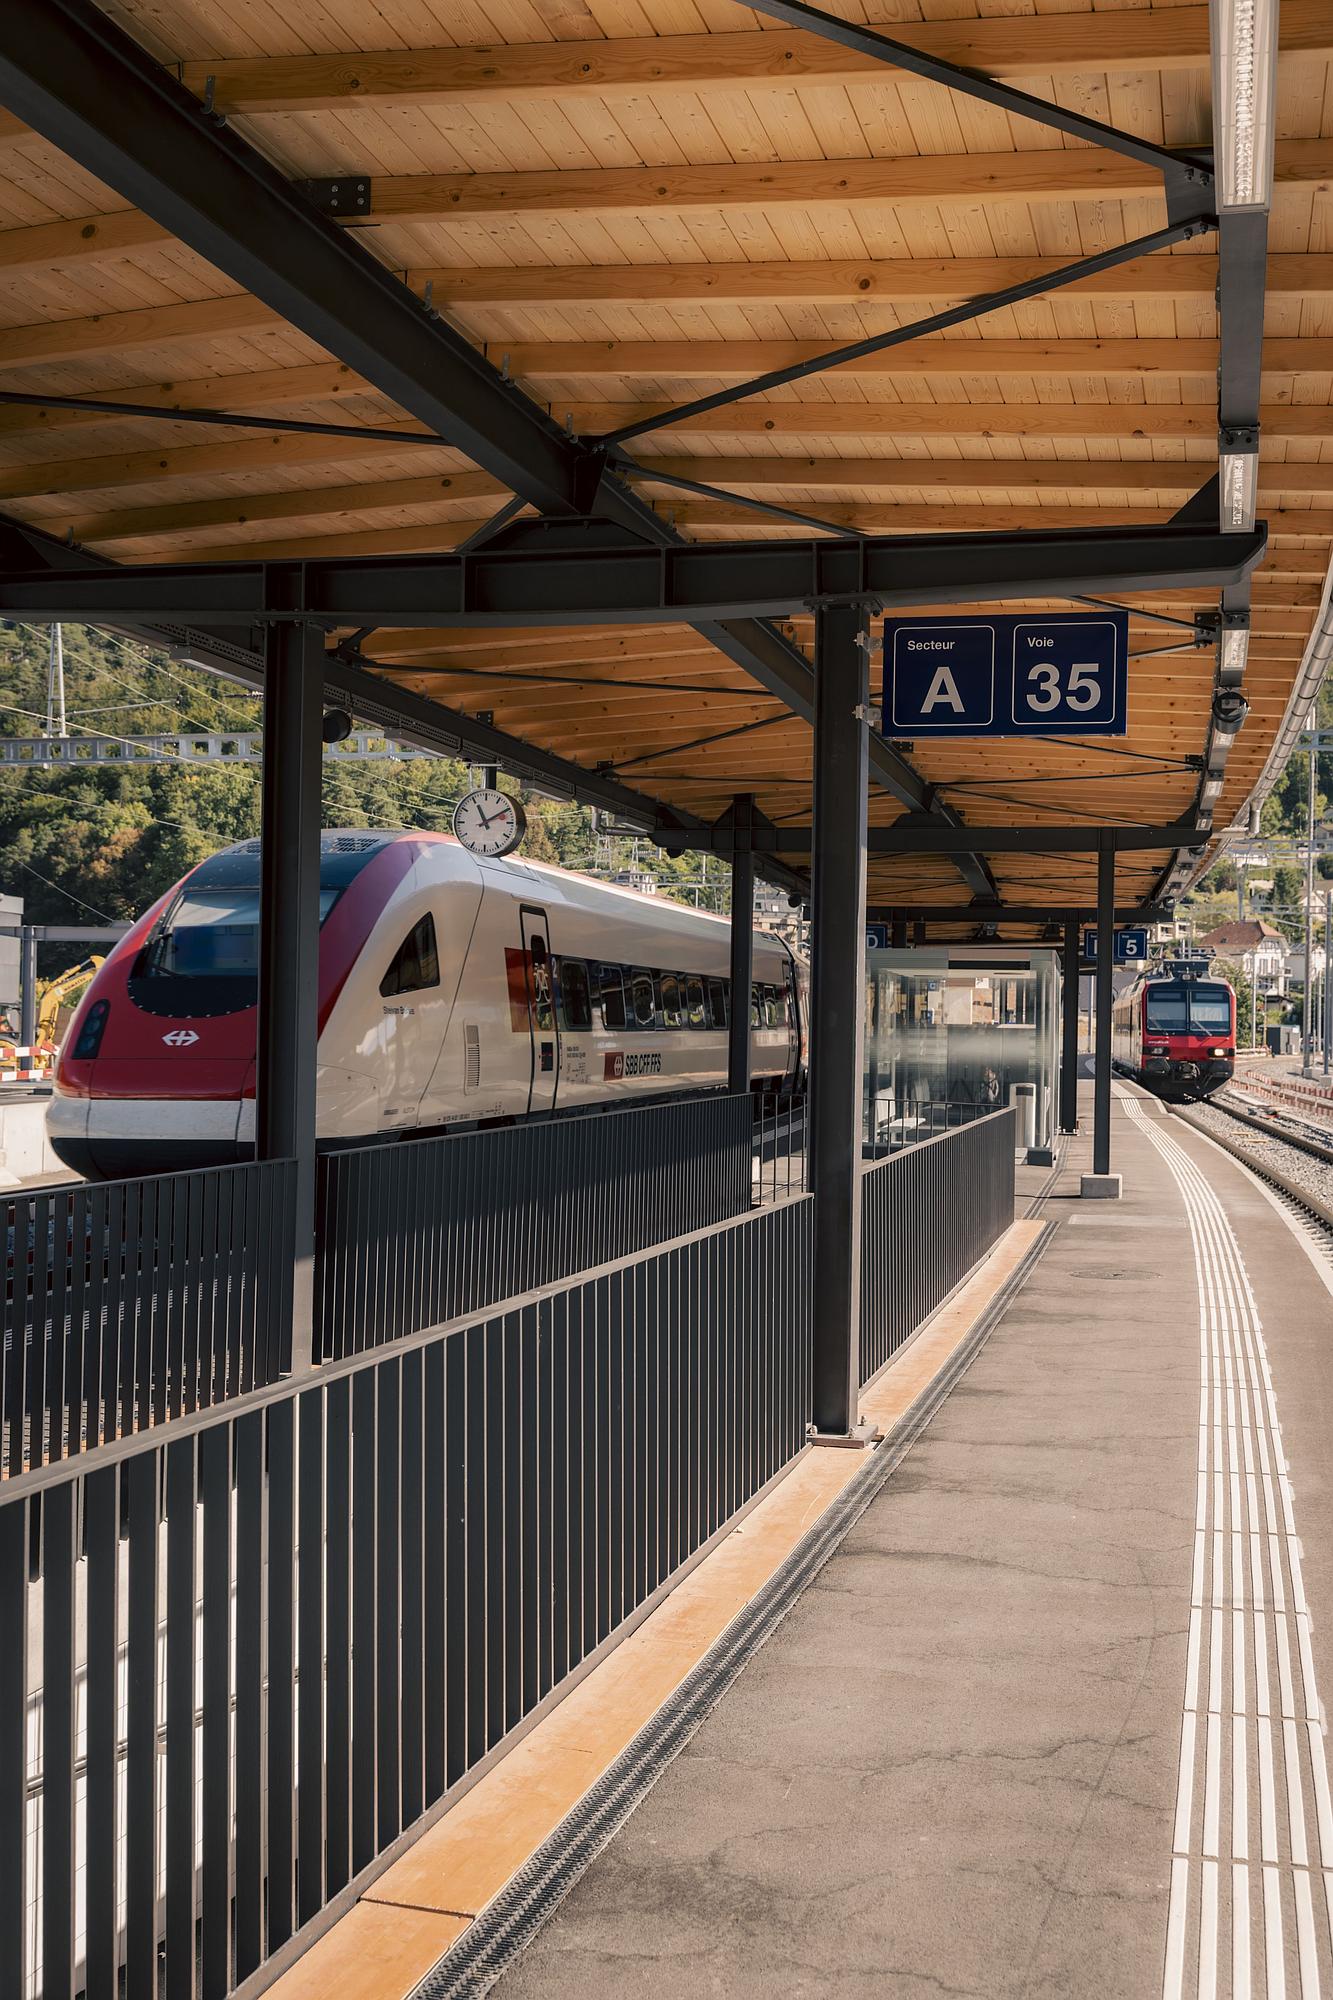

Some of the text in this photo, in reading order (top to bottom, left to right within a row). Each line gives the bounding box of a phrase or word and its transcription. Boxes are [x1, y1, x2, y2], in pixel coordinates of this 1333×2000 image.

[907, 640, 956, 651] Secteur
[1027, 637, 1054, 648] Voie
[920, 666, 966, 713] A
[1026, 662, 1101, 712] 35
[1125, 939, 1138, 956] 5
[625, 1052, 662, 1076] SBB CFF FFS
